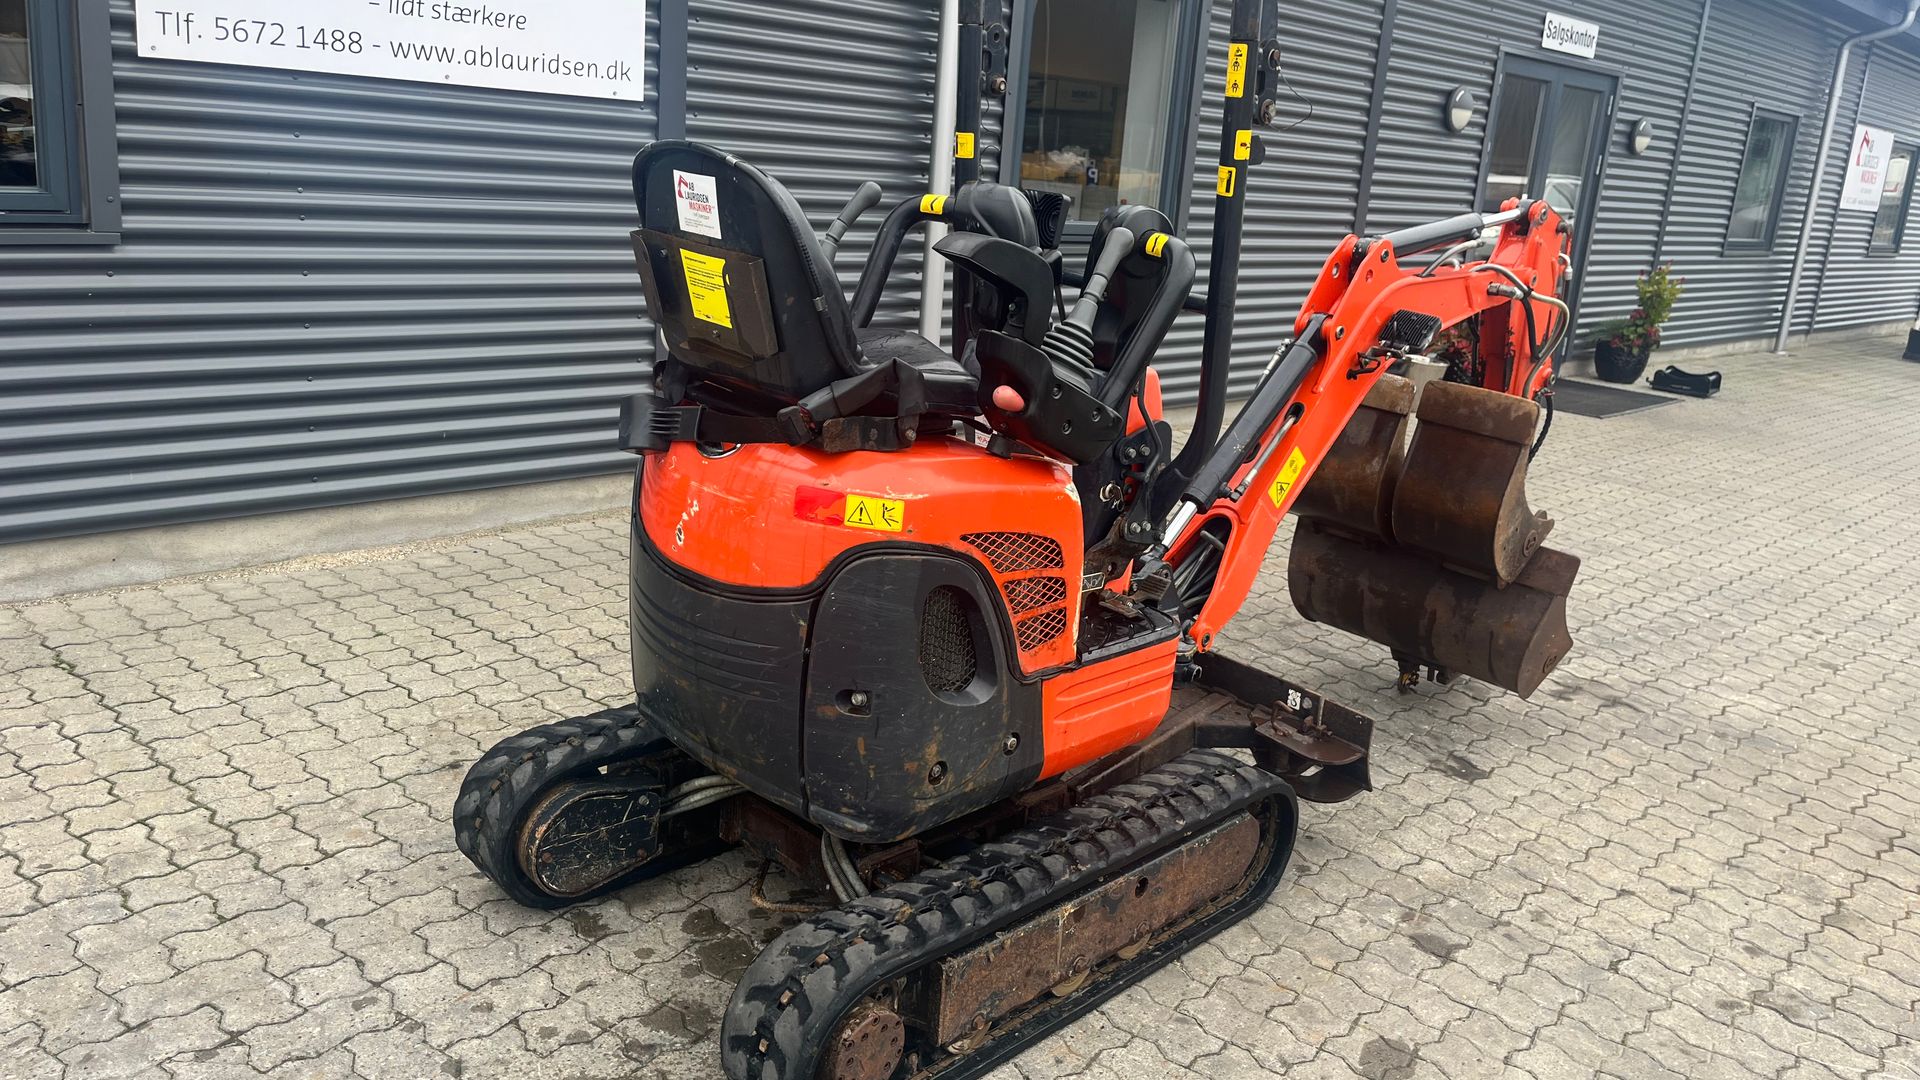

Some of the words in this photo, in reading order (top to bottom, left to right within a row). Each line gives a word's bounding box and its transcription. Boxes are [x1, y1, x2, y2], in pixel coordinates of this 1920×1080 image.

[431, 1, 527, 30] stærkere
[155, 11, 202, 44] Tlf.
[214, 16, 286, 46] 5672
[296, 25, 363, 54] 1488
[390, 40, 632, 82] www.ablauridsen.dk
[1546, 19, 1596, 49] Salgskontor
[684, 190, 709, 204] LAURIDSEN
[688, 201, 712, 214] MASKINER
